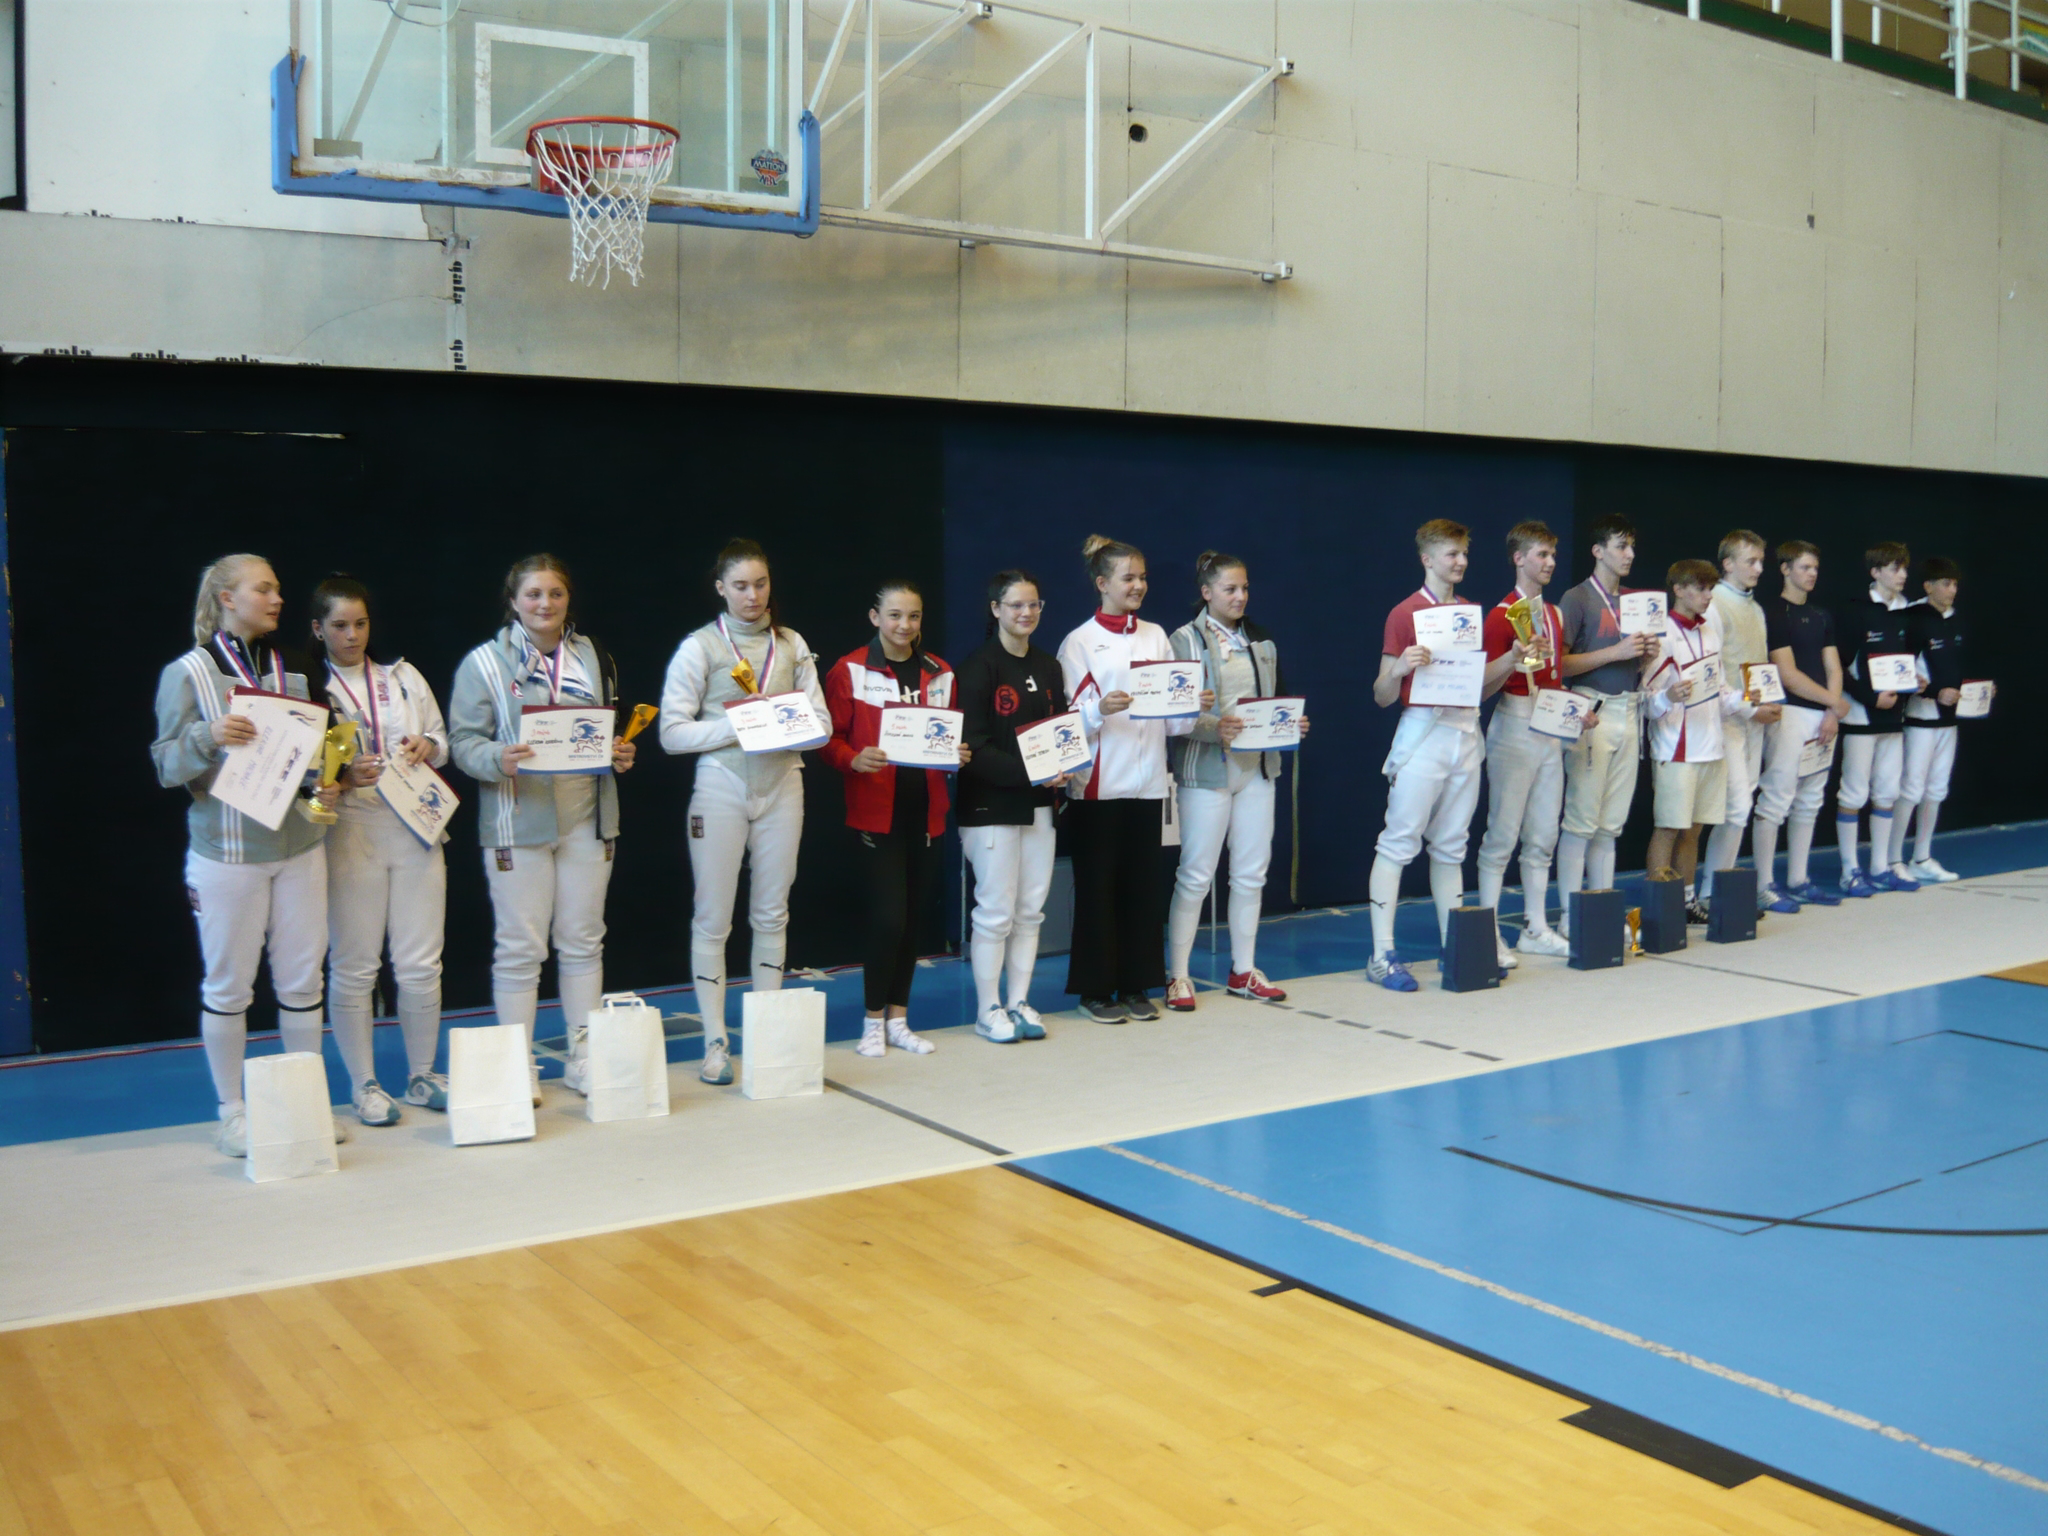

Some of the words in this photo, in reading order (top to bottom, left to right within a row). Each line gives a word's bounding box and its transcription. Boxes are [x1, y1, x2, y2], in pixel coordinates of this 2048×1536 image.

[759, 174, 778, 186] NBL
[447, 260, 466, 304] gala
[448, 339, 467, 371] gal
